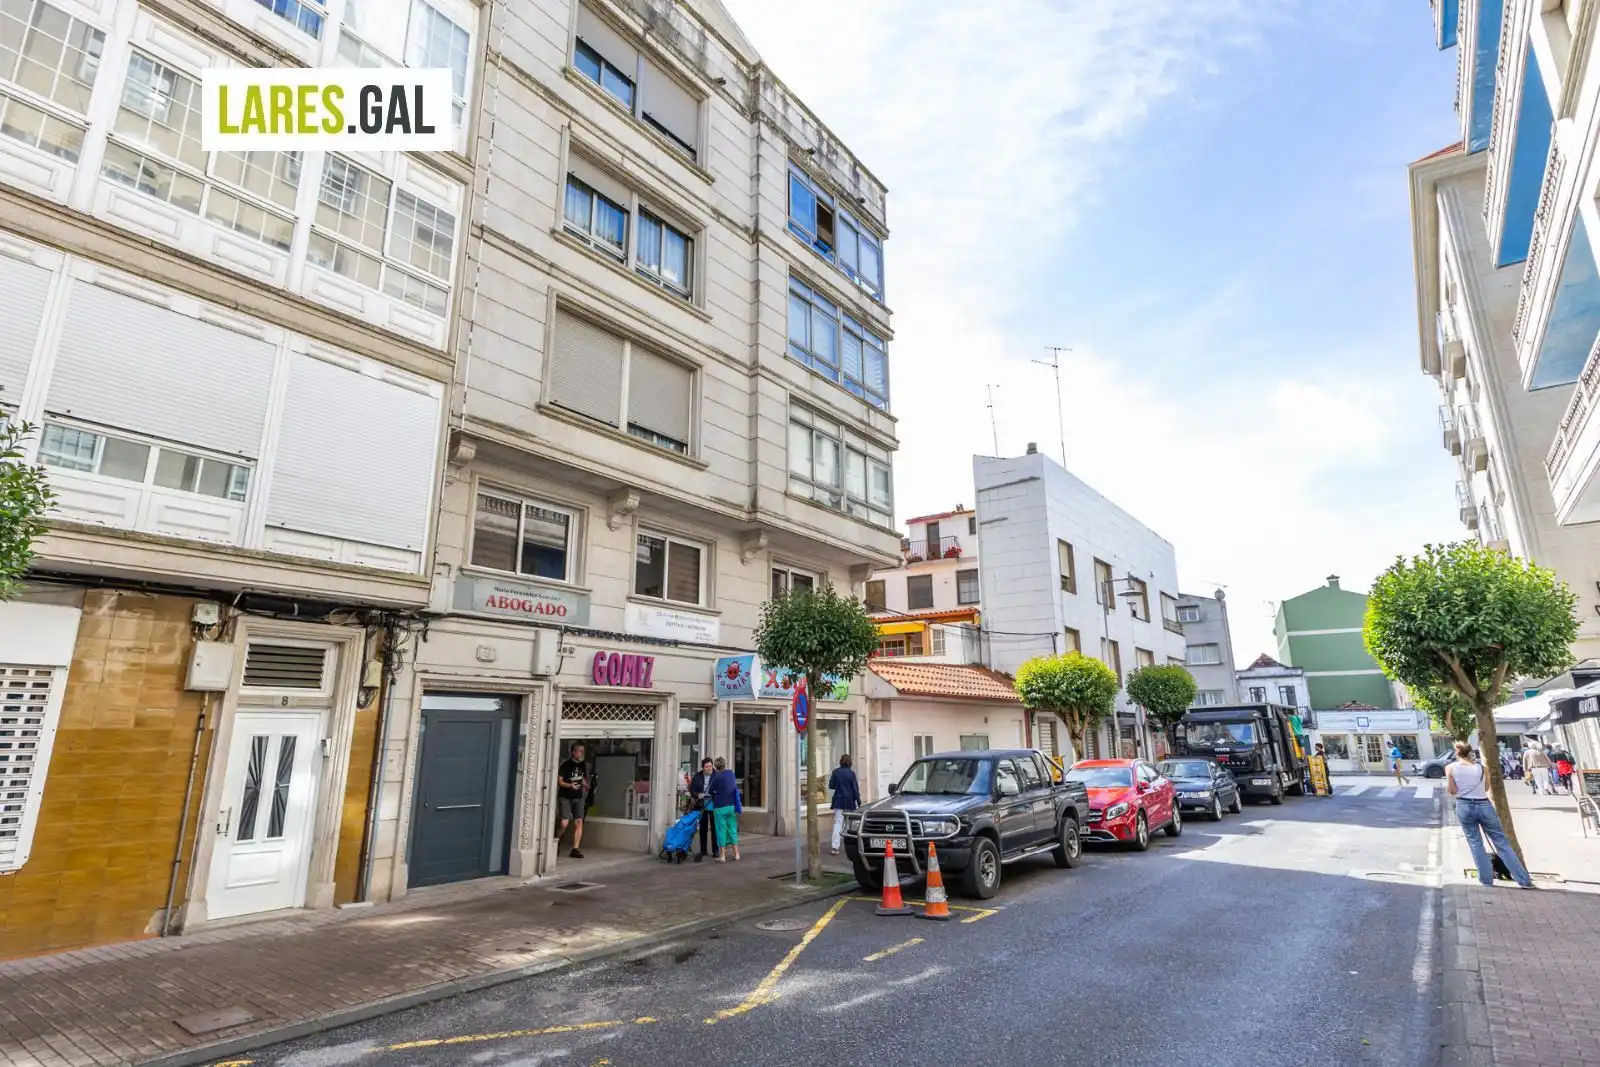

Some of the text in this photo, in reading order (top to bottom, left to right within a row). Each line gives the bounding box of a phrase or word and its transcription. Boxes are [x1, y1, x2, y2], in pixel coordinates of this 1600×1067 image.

[485, 594, 567, 617] ABOGADO
[593, 651, 654, 688] GOMEZ
[281, 696, 289, 706] 8
